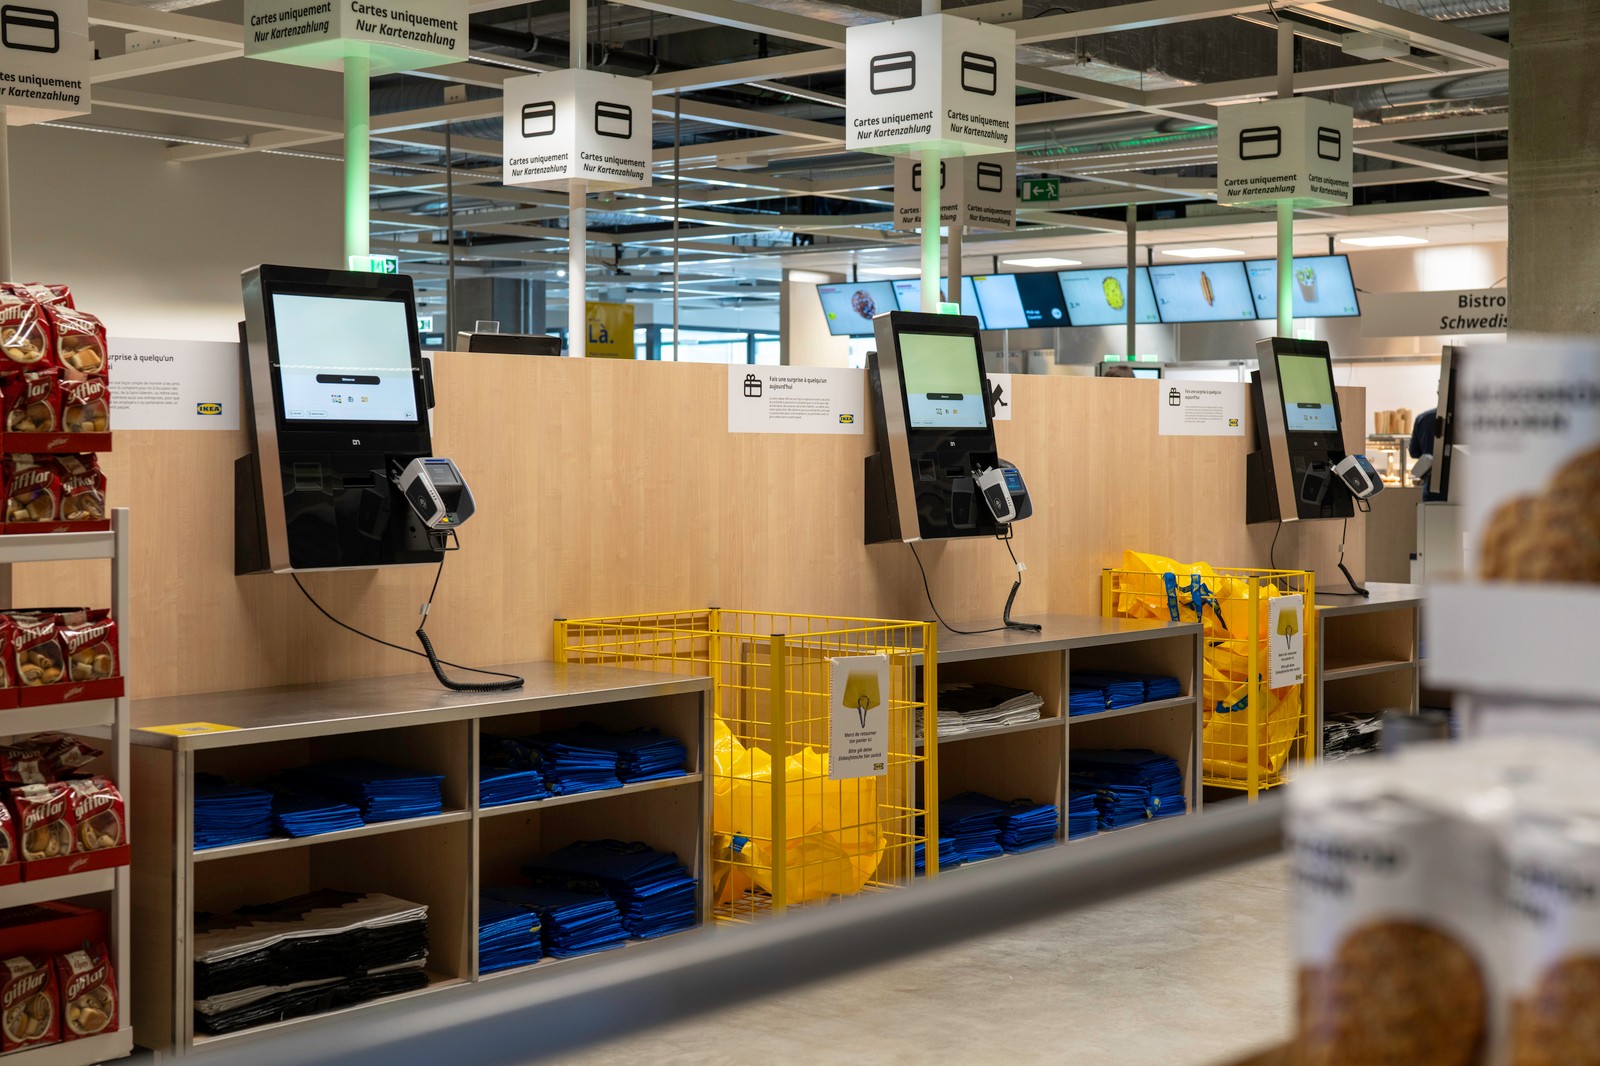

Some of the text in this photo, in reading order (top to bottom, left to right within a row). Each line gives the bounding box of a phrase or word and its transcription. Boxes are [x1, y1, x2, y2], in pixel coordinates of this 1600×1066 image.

[250, 1, 331, 27] Cartes uniquement
[351, 0, 458, 31] Cartes uniquement
[254, 19, 329, 43] Nur Kartenzahlung
[355, 19, 456, 50] Nur Kartenzahlung
[18, 74, 82, 89] uniquement
[8, 86, 80, 105] Kartenzahlung
[853, 110, 933, 127] Cartes uniquement
[947, 109, 1010, 129] Cartes uniquement
[857, 123, 931, 140] Nur Kartenzahlung
[950, 123, 1008, 143] Nur Kartenzahlung
[509, 153, 569, 166] Cartes uniquement
[580, 151, 646, 168] Cartes uniquement
[512, 164, 567, 177] Nur Kartenzahlung
[583, 163, 644, 180] Nur Kartenzahlung
[1224, 174, 1297, 187] Cartes uniquement
[1308, 173, 1349, 188] Cartes uniquement
[1227, 185, 1296, 197] Nur Kartenzahlung
[1310, 184, 1348, 199] Nur Kartenzahlung
[899, 207, 919, 215] Cartes
[967, 203, 983, 213] Cartes
[983, 206, 1012, 216] uniquement
[969, 213, 1011, 226] Nur Kartenzahlung
[1458, 294, 1506, 308] Bistro
[139, 354, 174, 363] quelqu'un
[25, 800, 64, 829] gifflar
[3, 973, 46, 1008] gifflar
[68, 966, 105, 1000] gifflar
